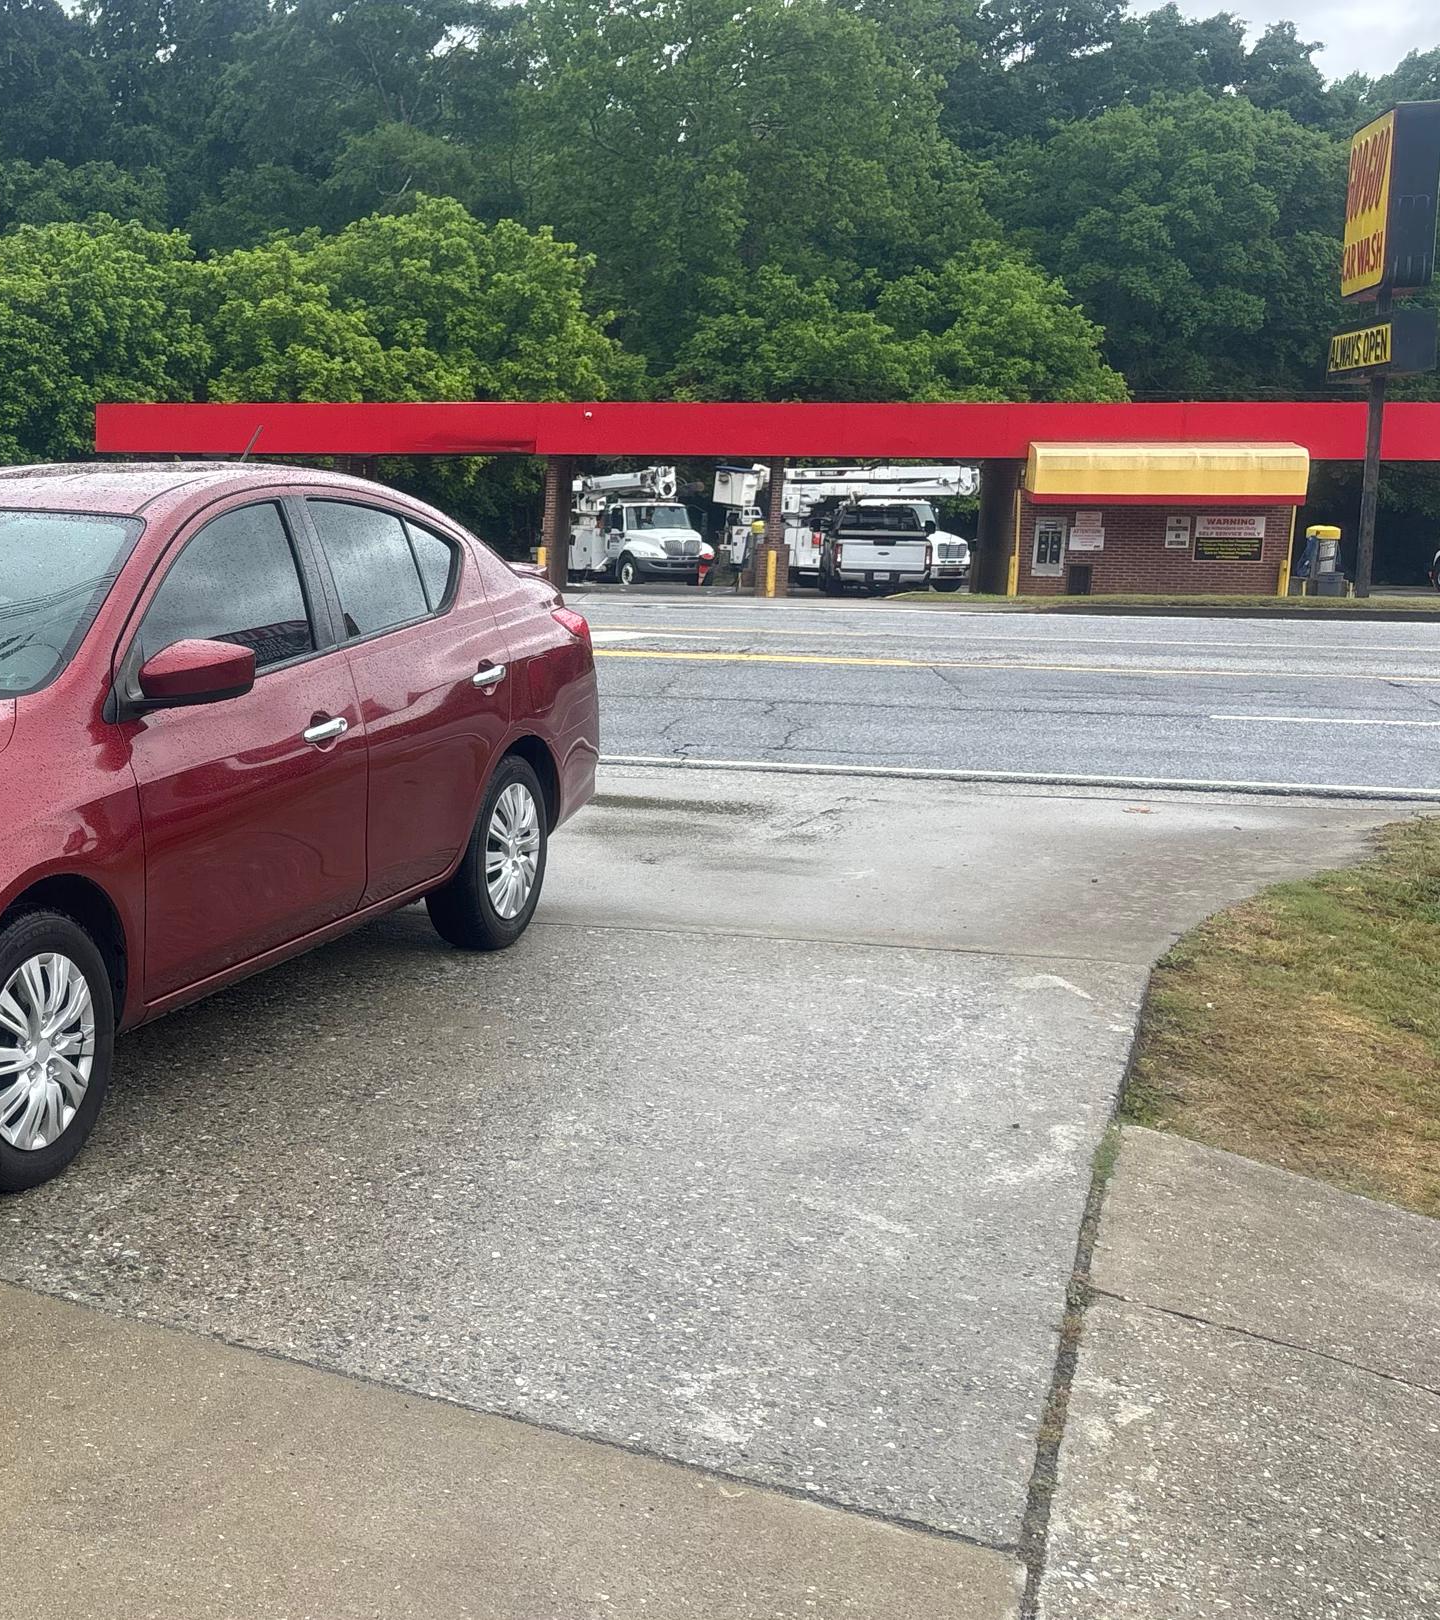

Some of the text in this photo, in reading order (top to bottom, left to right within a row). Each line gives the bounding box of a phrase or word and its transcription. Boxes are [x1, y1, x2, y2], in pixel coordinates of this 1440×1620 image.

[1357, 231, 1384, 276] WASH
[1329, 327, 1388, 370] ALWAYS OPEN
[1207, 518, 1256, 526] WARNING
